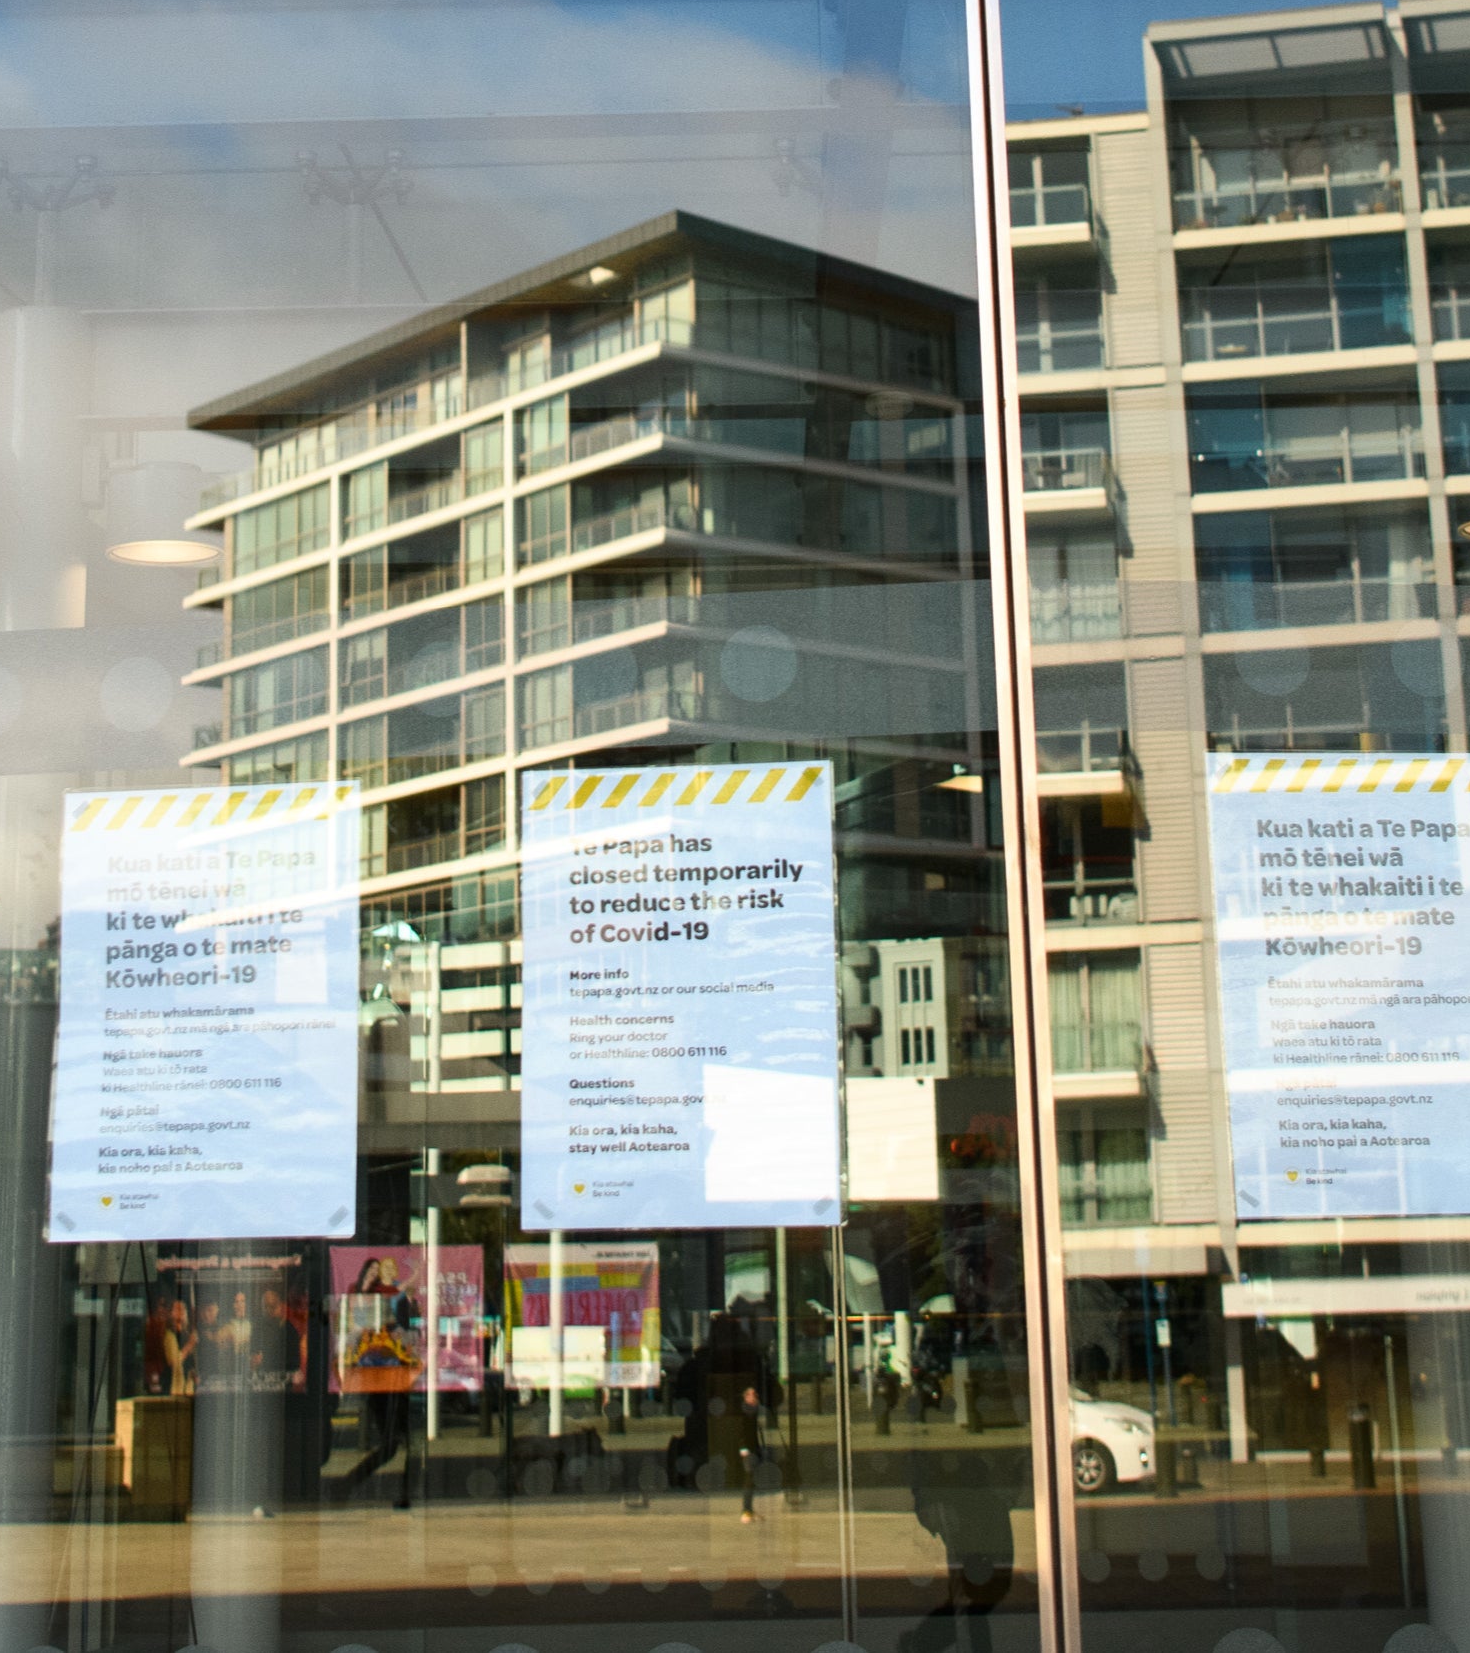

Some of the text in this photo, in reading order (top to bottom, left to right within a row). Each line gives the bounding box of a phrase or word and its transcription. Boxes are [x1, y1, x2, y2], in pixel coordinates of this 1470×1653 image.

[1257, 818, 1470, 842] Kua kati a Te Papa
[603, 837, 664, 859] Papa
[670, 835, 712, 852] has
[1260, 847, 1403, 867] mō tēnei wā
[569, 859, 802, 885] closed temporarily
[1262, 876, 1462, 897] ki te whakaiti i te
[570, 889, 783, 914] to reduce the risk
[1344, 910, 1358, 924] o
[1364, 908, 1387, 925] te
[1393, 907, 1454, 925] mate
[570, 922, 709, 943] of Covid-19
[106, 937, 291, 964] pānga o te mate
[1265, 936, 1421, 956] Kōwheori-19
[107, 965, 256, 988] Kōwheori-19
[570, 969, 629, 980] More info
[570, 1015, 674, 1025] Health concerns
[570, 1079, 634, 1089] Questions
[1279, 1119, 1386, 1131] Kia ora, kia kaha,
[1281, 1136, 1430, 1150] kia noho pai a Aotearoa
